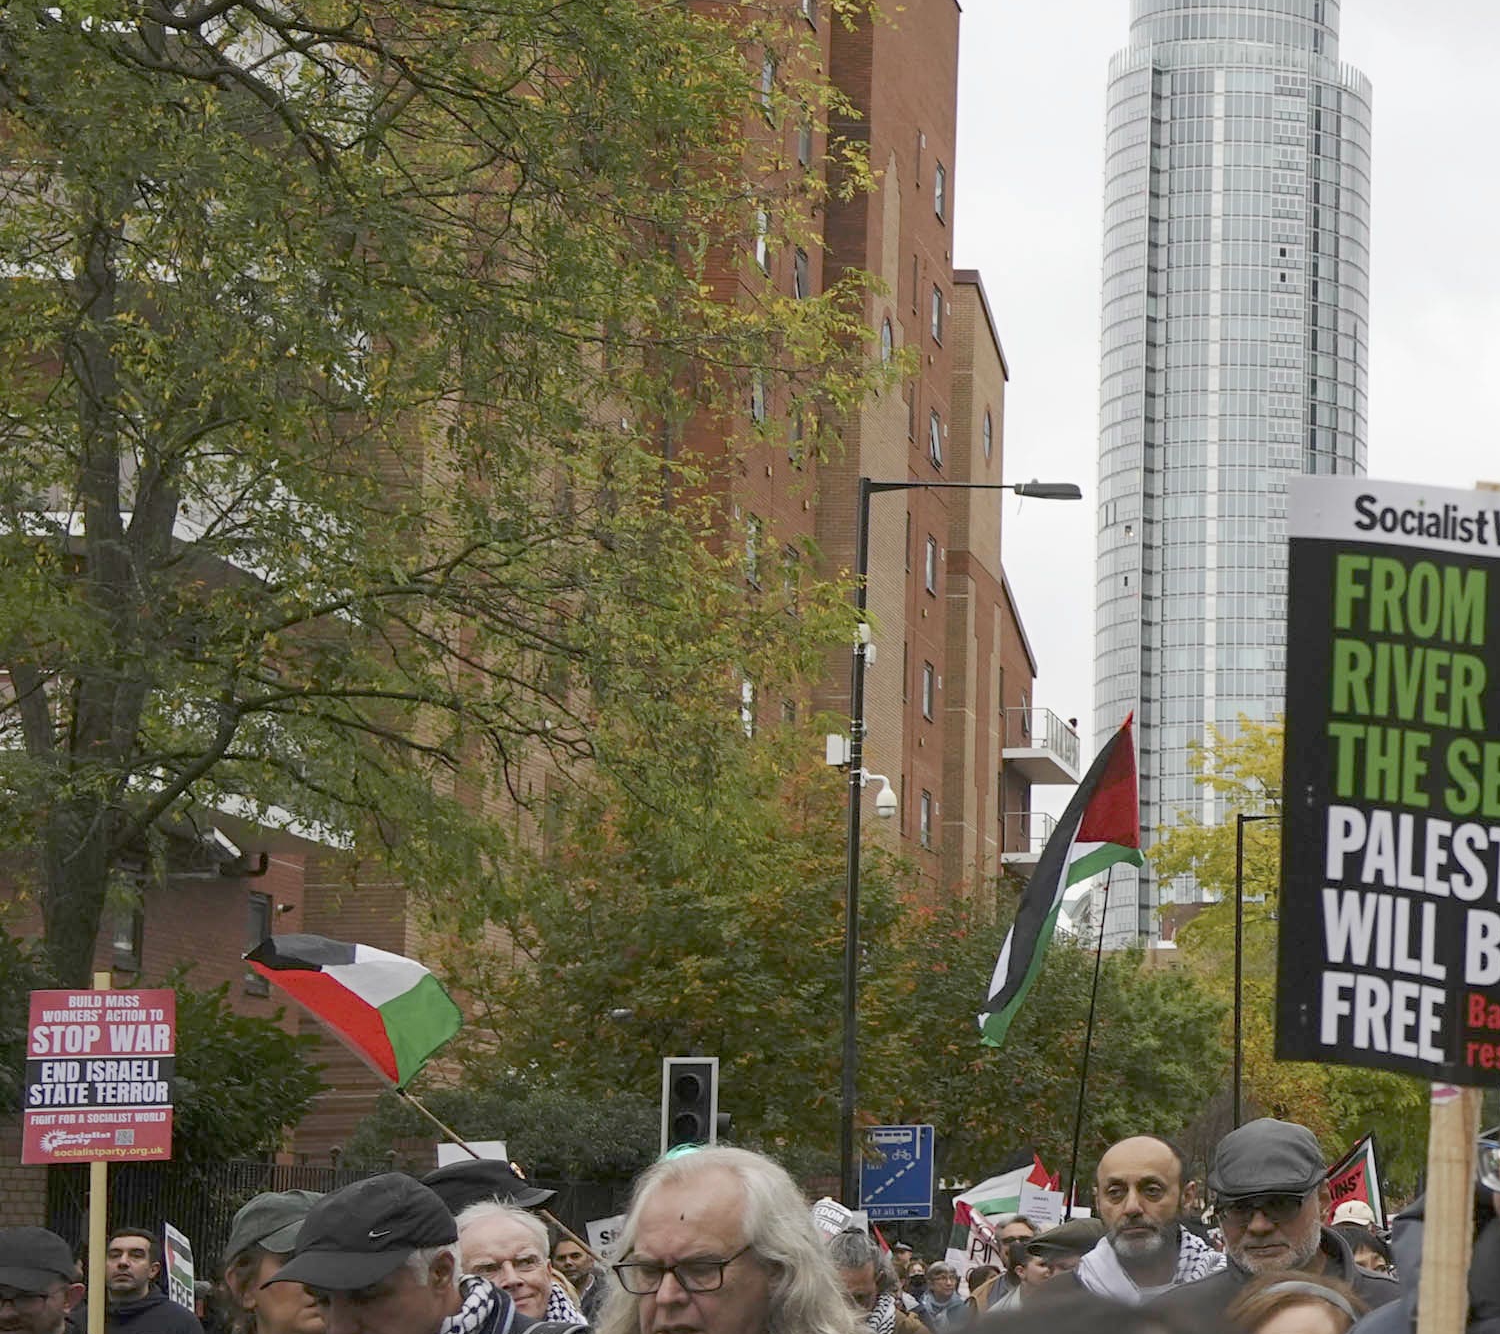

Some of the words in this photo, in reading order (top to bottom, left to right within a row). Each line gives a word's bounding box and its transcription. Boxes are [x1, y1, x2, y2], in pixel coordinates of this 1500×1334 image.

[1355, 495, 1488, 545] Socialist
[1335, 554, 1487, 646] FROM
[1331, 639, 1487, 731] RIVER
[1329, 723, 1430, 809] THE
[1322, 887, 1446, 981] WILL
[69, 996, 101, 1008] BUILD
[105, 995, 139, 1008] MASS
[106, 1009, 146, 1021] ACTION
[150, 1009, 163, 1021] TO
[1320, 971, 1446, 1063] FREE
[32, 1025, 100, 1054] STOP
[109, 1024, 170, 1052] WAR
[41, 1062, 80, 1083] END
[86, 1060, 158, 1082] ISRAELI
[30, 1083, 88, 1105] STATE
[95, 1082, 168, 1103] TERROR
[31, 1115, 56, 1125] FIGHT
[59, 1114, 76, 1124] FOR
[78, 1114, 85, 1124] A
[87, 1113, 132, 1123] SOCIALIST
[135, 1112, 166, 1122] WORLD
[54, 1147, 164, 1157] socialistparty.org.uk
